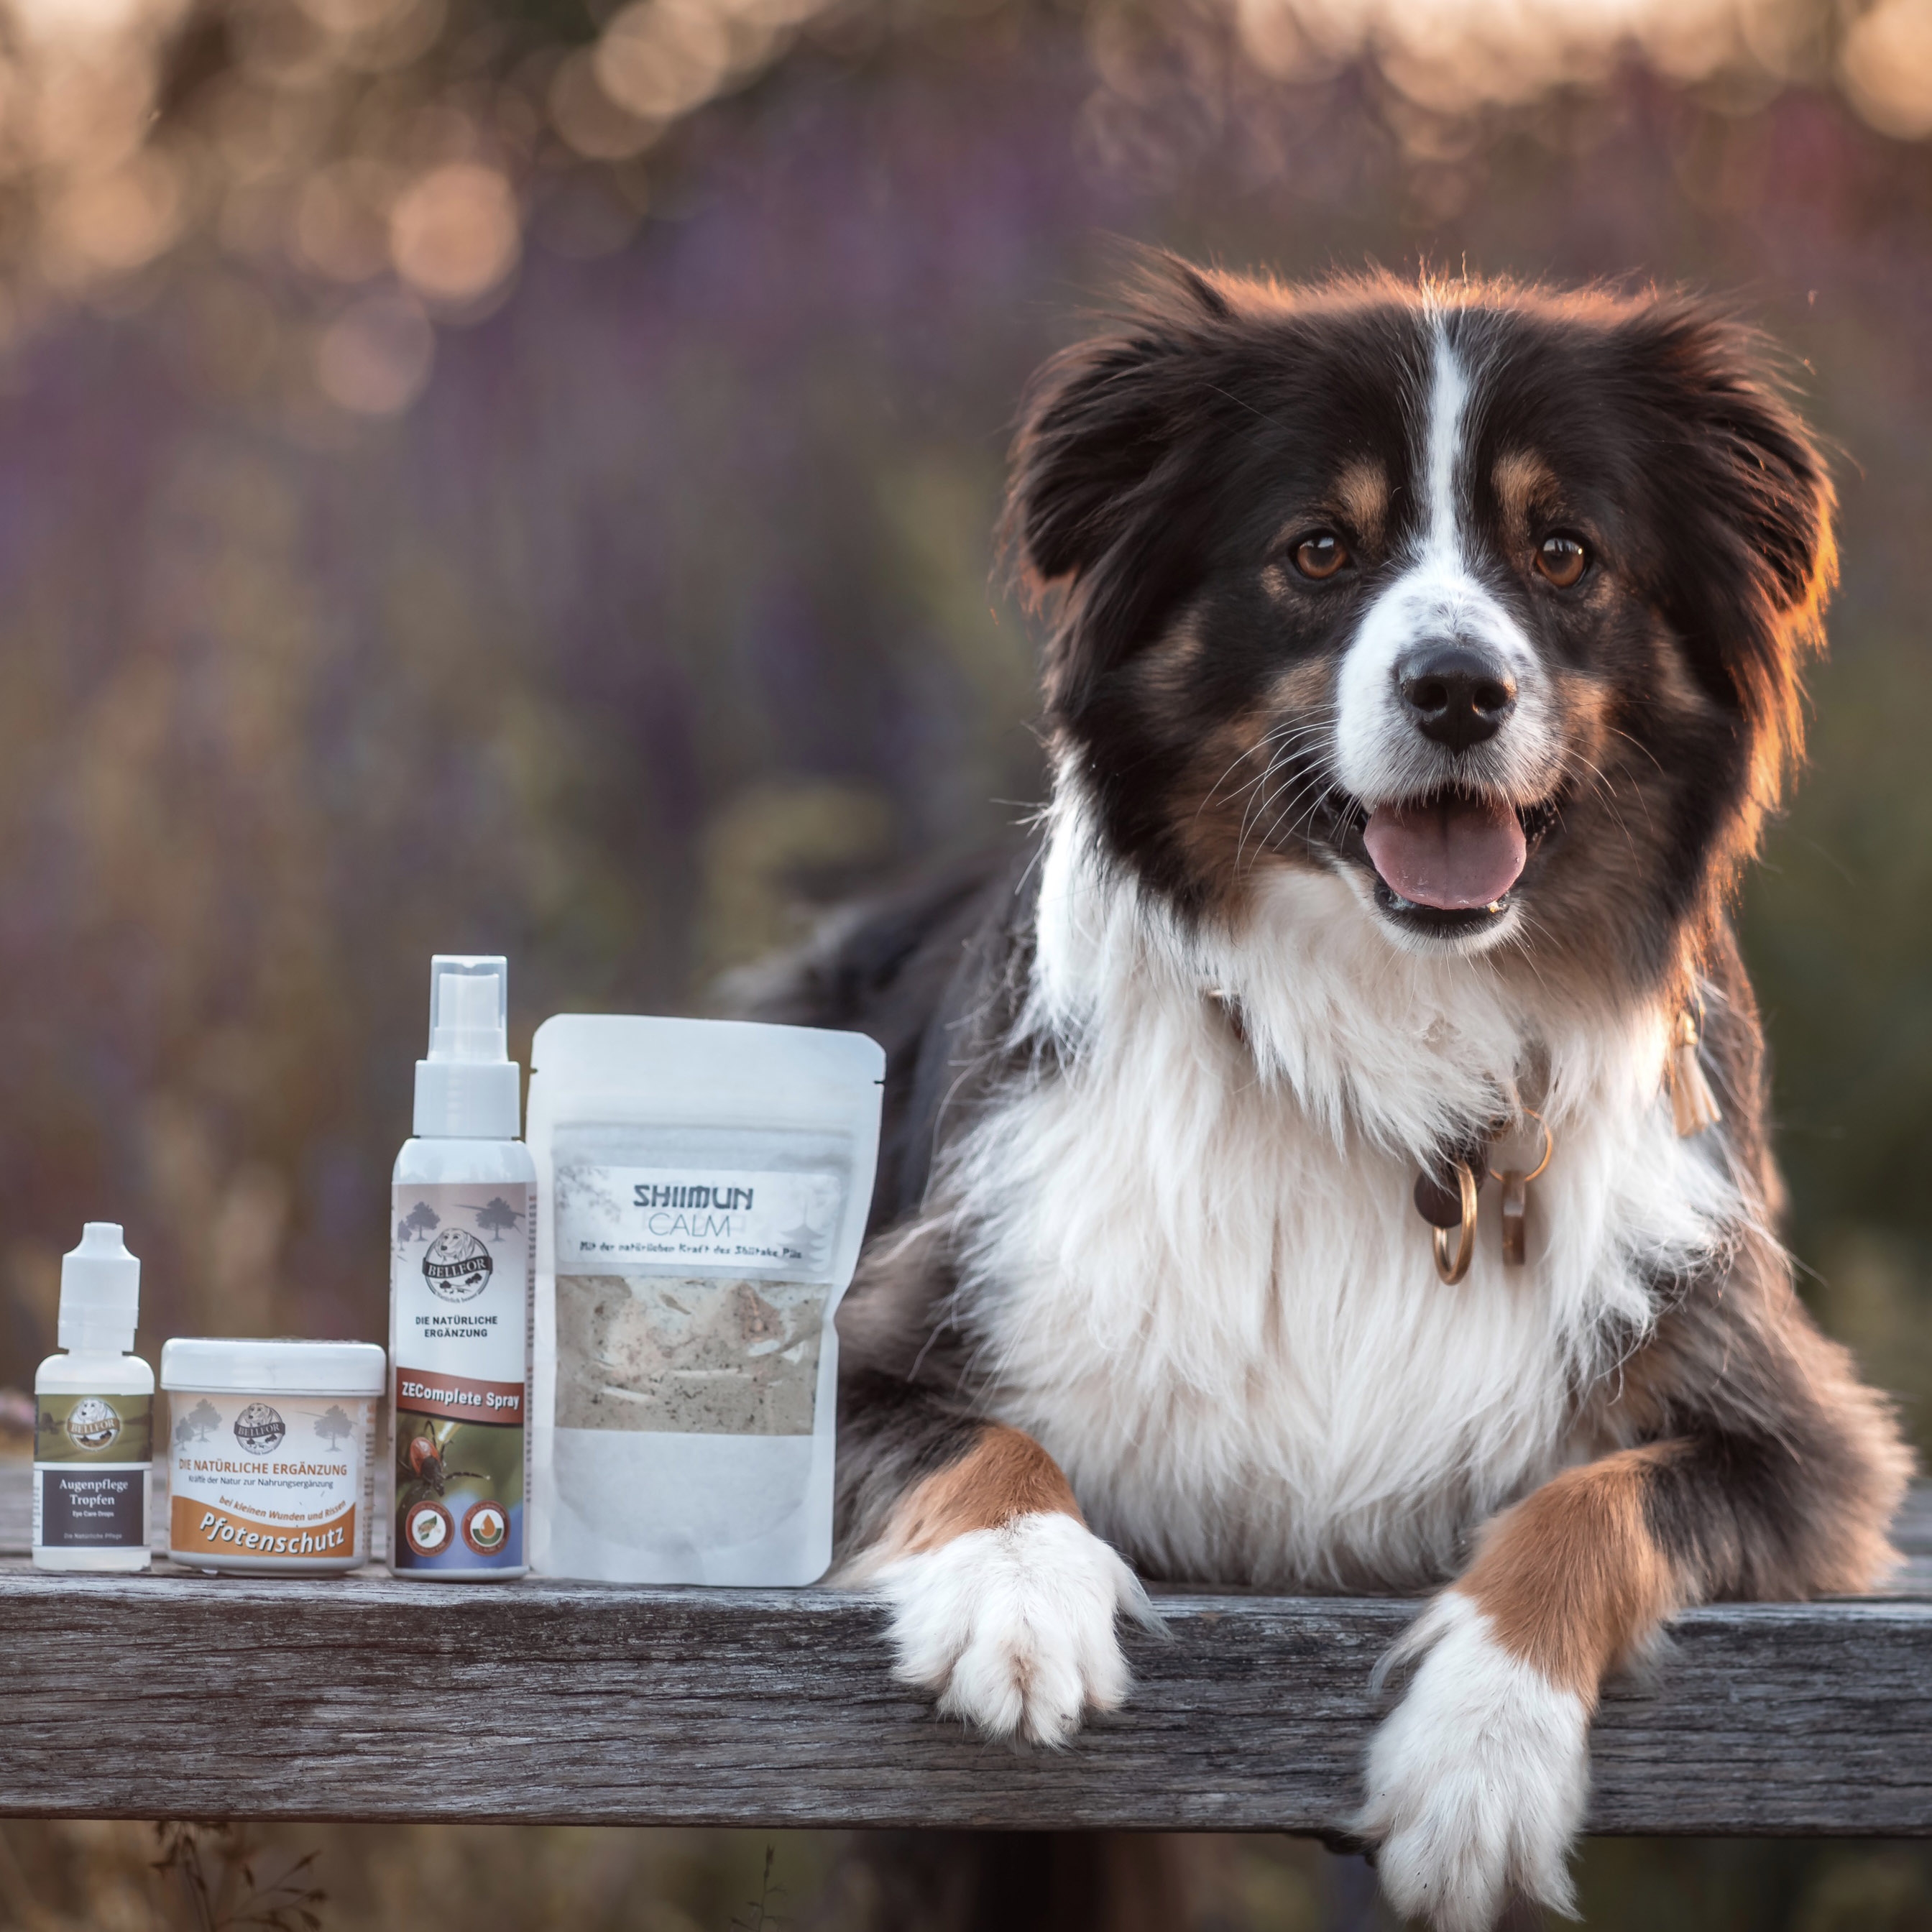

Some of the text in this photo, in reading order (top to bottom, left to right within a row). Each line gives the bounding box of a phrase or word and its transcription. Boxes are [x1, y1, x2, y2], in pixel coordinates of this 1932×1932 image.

[633, 1184, 753, 1210] SHIIMUN
[648, 1212, 730, 1238] CALM
[599, 1241, 615, 1251] der
[678, 1243, 709, 1254] Kraft
[713, 1245, 730, 1254] des
[427, 1258, 487, 1278] BELLFOR
[415, 1315, 498, 1325] DIE NATÜRLICHE
[424, 1328, 488, 1338] ERGÄNZUNG
[402, 1381, 520, 1410] ZEComplete Spray
[71, 1418, 116, 1434] BELLFOR
[238, 1423, 280, 1436] BELLFOR
[179, 1458, 348, 1476] DIE NATÜRLICHE ERGÄNZUNG
[59, 1478, 129, 1493] Augenpflege
[207, 1476, 218, 1484] der
[220, 1477, 241, 1486] Natur
[257, 1478, 334, 1489] Nahrungsergänzung
[69, 1494, 115, 1508] Tropfen
[218, 1495, 346, 1521] bei kleinen Wunden und Rissen
[200, 1512, 345, 1554] Pfotenschutz
